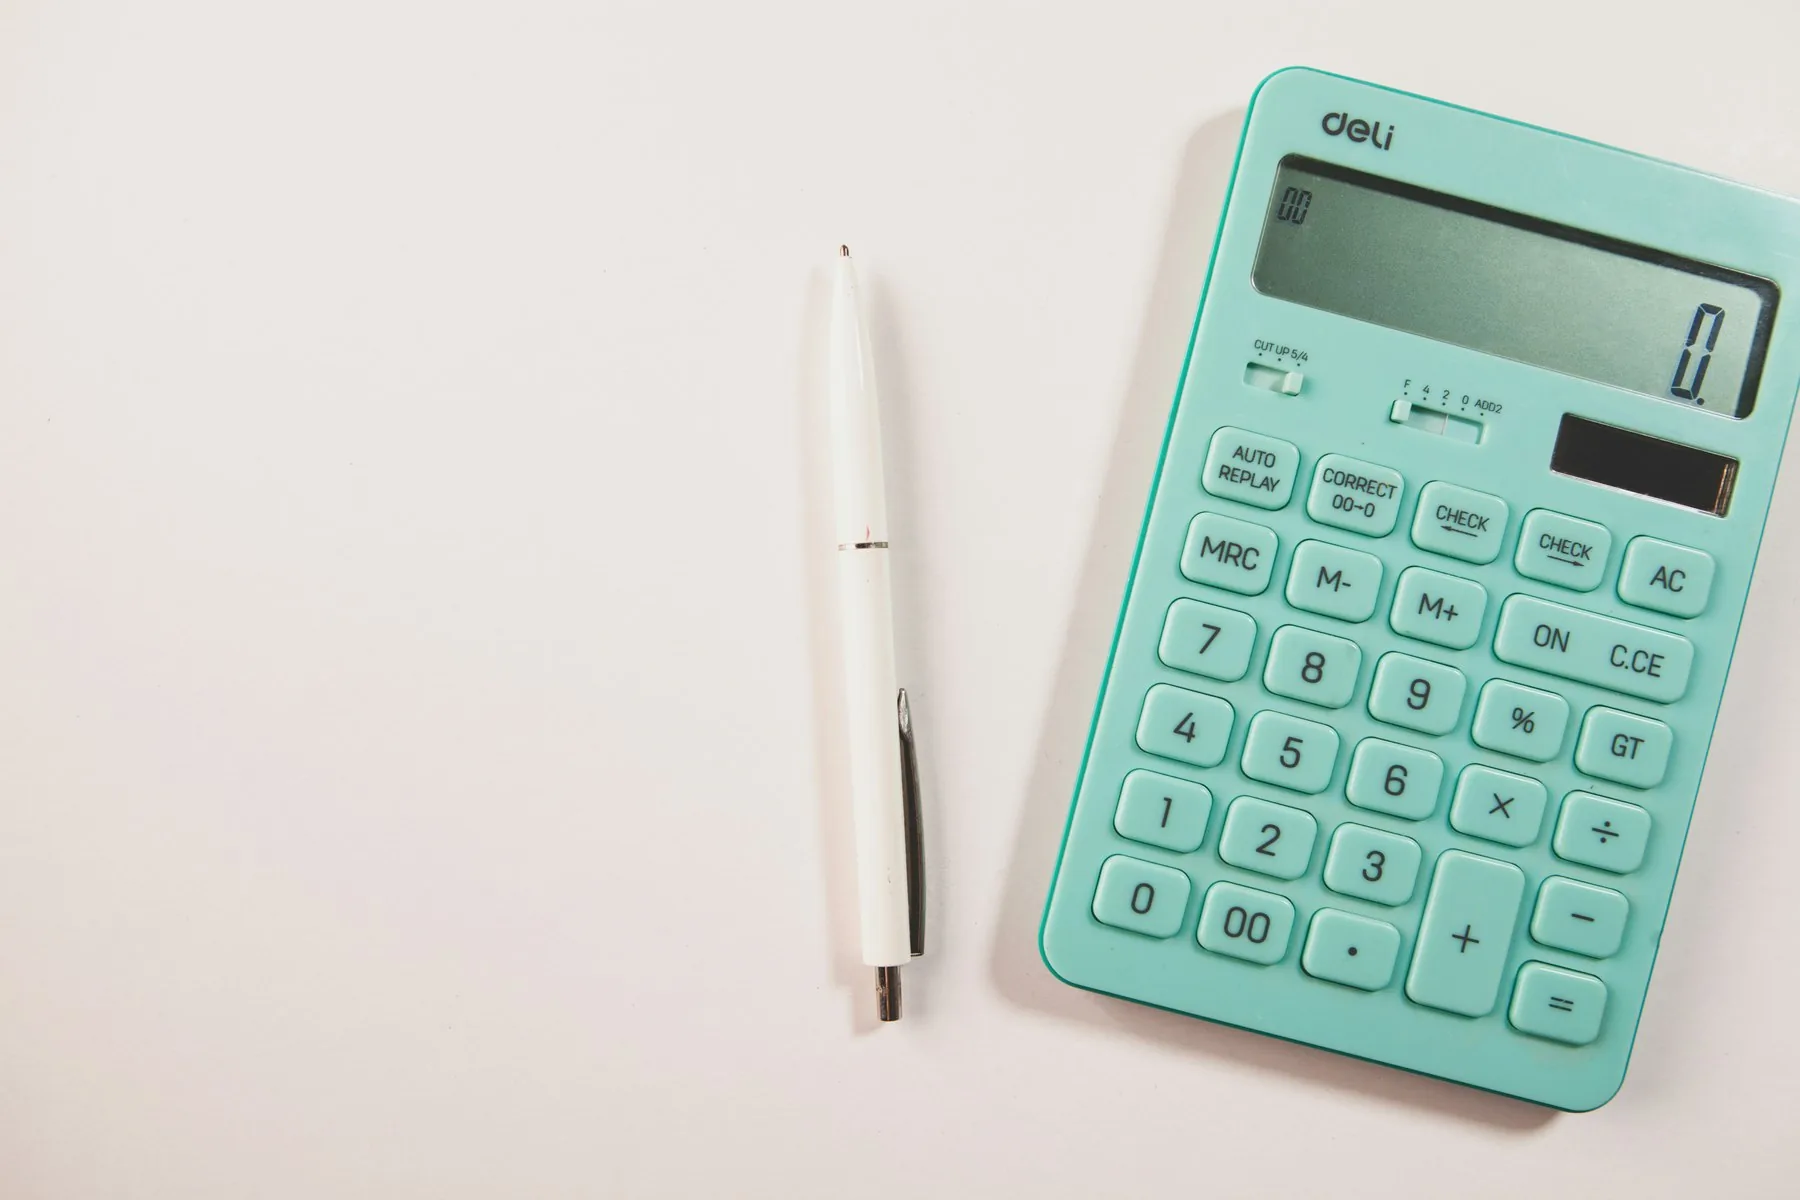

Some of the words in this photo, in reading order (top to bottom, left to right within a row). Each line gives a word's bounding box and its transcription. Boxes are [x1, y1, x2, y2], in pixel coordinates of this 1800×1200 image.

[1321, 112, 1395, 151] deli
[1254, 339, 1275, 352] CUT
[1275, 345, 1291, 356] UP
[1290, 348, 1309, 362] 5/4
[1403, 378, 1412, 388] F
[1422, 384, 1430, 395] 4
[1442, 389, 1450, 400] 2
[1461, 394, 1470, 405] 0
[1474, 398, 1503, 414] ADD2
[1232, 445, 1276, 470] AUTO
[1218, 464, 1281, 493] REPLAY
[1322, 467, 1398, 500] CORRECT
[1435, 504, 1490, 532] CHECK
[1200, 535, 1260, 571] MRC
[1539, 533, 1593, 560] CHECK
[1649, 565, 1686, 593] AC
[1418, 592, 1459, 622] M+
[1199, 623, 1222, 655] 7
[1533, 624, 1571, 653] ON
[1301, 651, 1326, 684] 8
[1406, 678, 1431, 711] 9
[1172, 712, 1196, 744] 4
[1511, 707, 1535, 734] %
[1279, 736, 1304, 769] 5
[1610, 733, 1645, 760] GT
[1383, 764, 1408, 797] 6
[1160, 796, 1173, 829] 1
[1255, 823, 1281, 857] 2
[1362, 850, 1386, 882] 3
[1130, 882, 1155, 915] 0
[1223, 905, 1271, 944] 00
